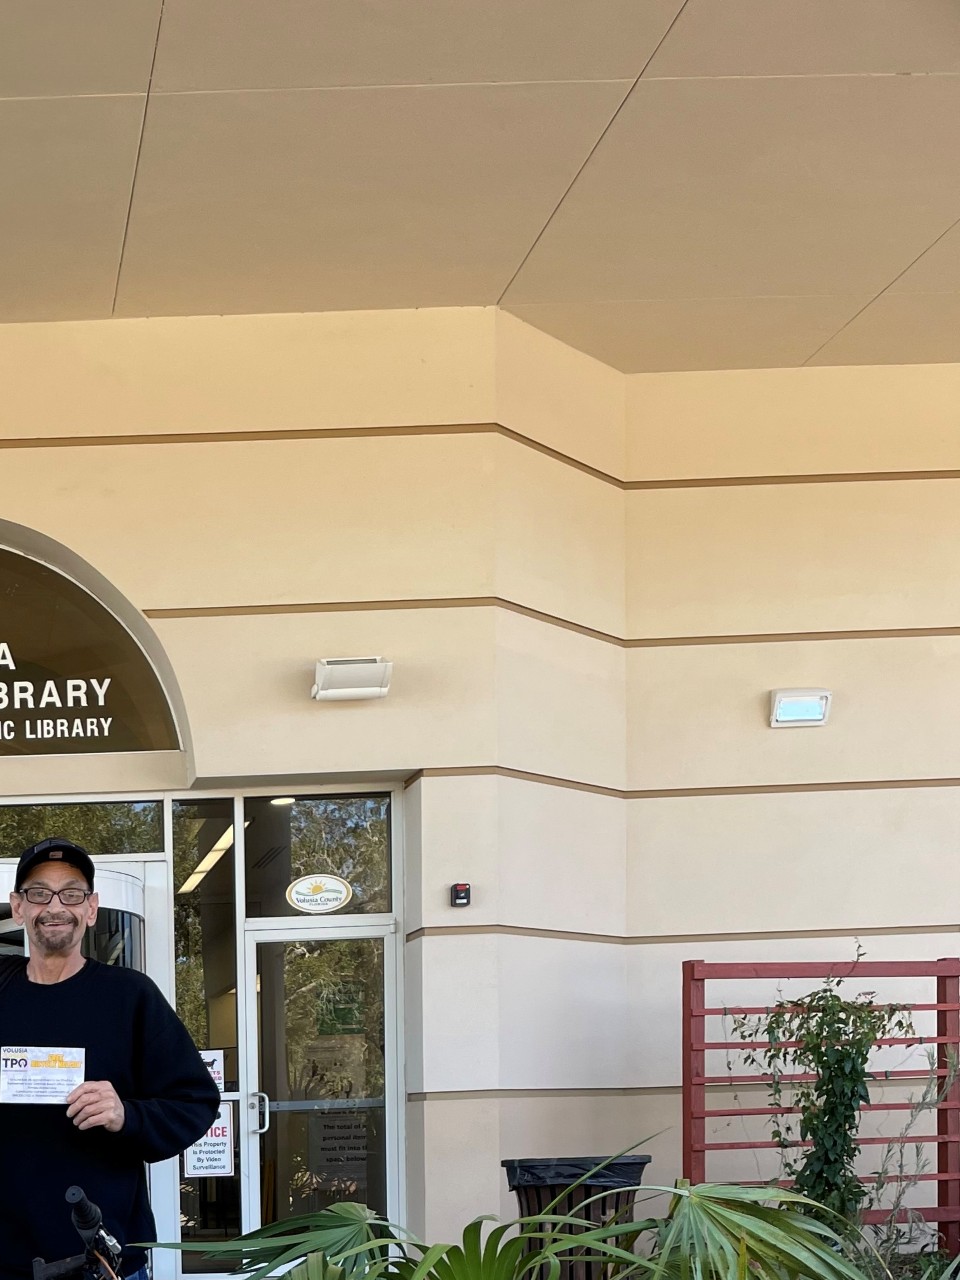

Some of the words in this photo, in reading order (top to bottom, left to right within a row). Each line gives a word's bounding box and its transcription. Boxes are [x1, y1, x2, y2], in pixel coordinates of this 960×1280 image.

[25, 717, 113, 739] LIBRARY
[2, 1058, 28, 1069] TPO
[206, 1126, 227, 1137] TICE
